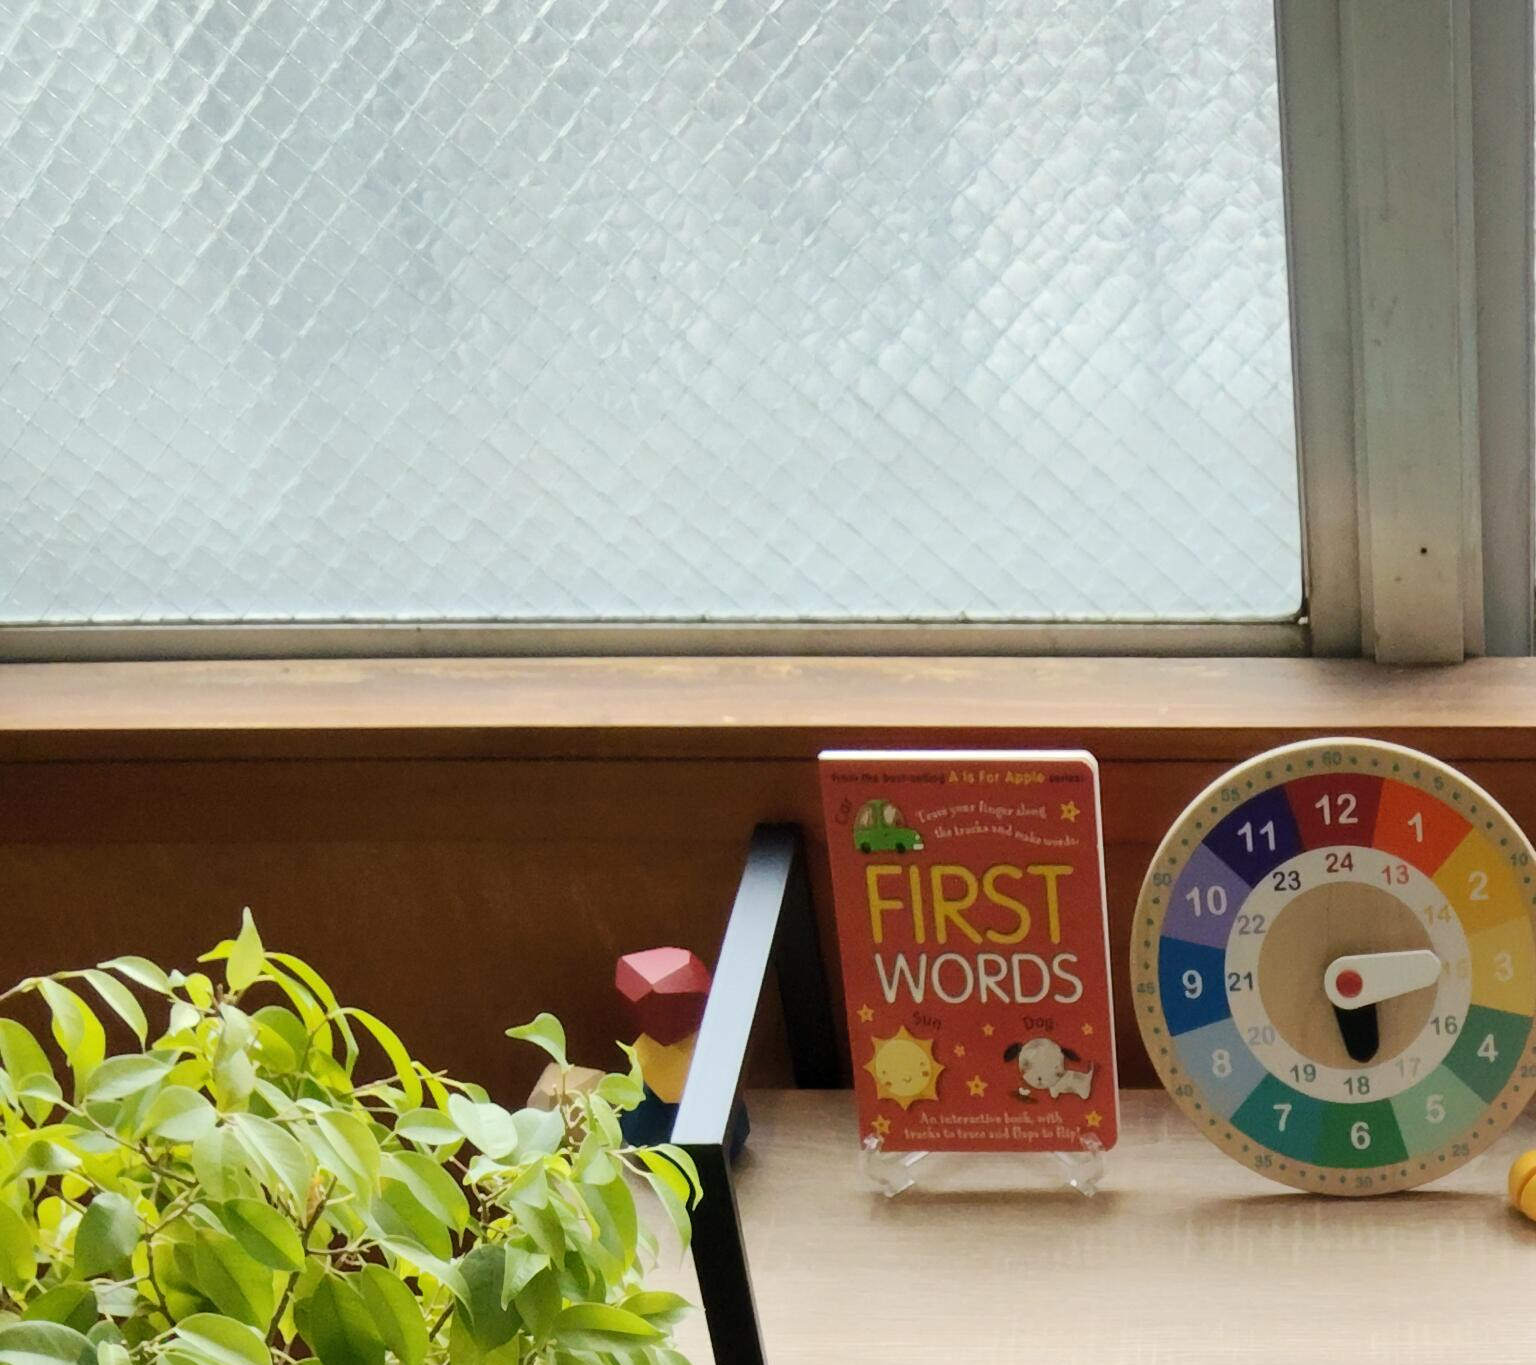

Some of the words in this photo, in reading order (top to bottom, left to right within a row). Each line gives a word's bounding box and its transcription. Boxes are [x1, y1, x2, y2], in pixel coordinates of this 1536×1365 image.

[948, 770, 959, 783] A
[979, 770, 1000, 784] For
[1004, 770, 1046, 785] Apple
[1433, 775, 1445, 791] 5
[979, 800, 1014, 820] finger
[1015, 802, 1048, 820] along
[1314, 793, 1359, 826] 12
[1236, 821, 1278, 853] 11
[1407, 812, 1425, 843] 1
[1325, 852, 1354, 873] 24
[1508, 851, 1530, 868] 10
[1272, 870, 1302, 892] 23
[1381, 865, 1410, 886] 13
[1467, 870, 1490, 901] 2
[865, 864, 1074, 945] FIRST
[1185, 885, 1228, 917] 10
[1236, 913, 1267, 935] 22
[1423, 904, 1453, 925] 14
[874, 952, 1084, 1005] WORDS
[1493, 953, 1514, 983] 3
[1136, 981, 1156, 995] 45
[1181, 970, 1204, 999] 9
[1227, 971, 1254, 992] 21
[912, 1011, 943, 1031] Sun
[1023, 1015, 1055, 1032] Dog
[1430, 1015, 1459, 1037] 16
[1247, 1025, 1277, 1046] 20
[1476, 1033, 1500, 1063] 4
[1211, 1049, 1233, 1079] 8
[1289, 1063, 1318, 1084] 19
[1396, 1056, 1423, 1078] 17
[1173, 1083, 1194, 1098] 40
[1342, 1075, 1372, 1097] 18
[919, 1112, 938, 1125] An
[1272, 1103, 1293, 1132] 7
[1425, 1095, 1446, 1124] 5
[1350, 1121, 1372, 1150] 6
[1253, 1154, 1274, 1169] 35
[1451, 1143, 1471, 1158] 25
